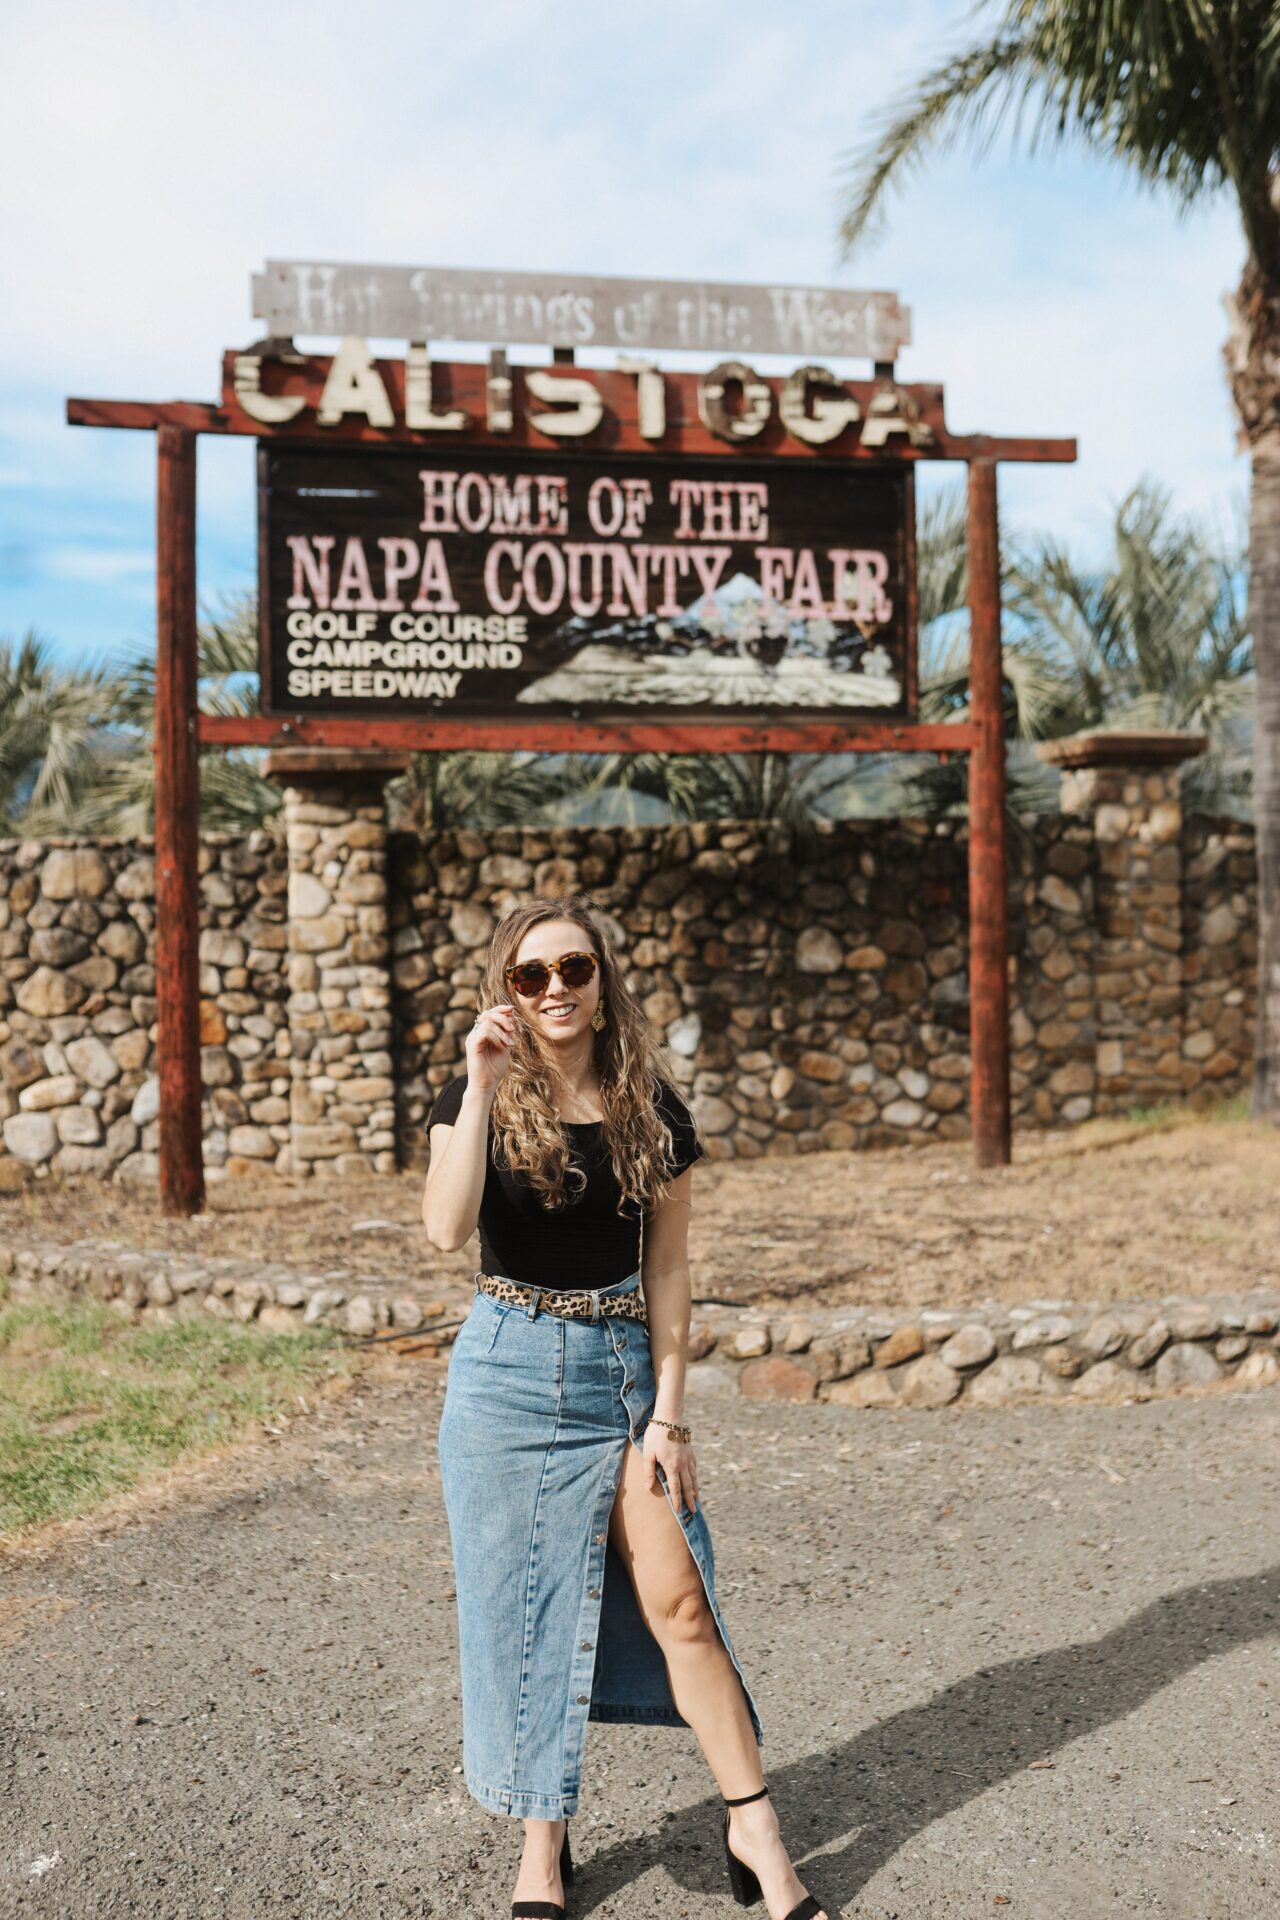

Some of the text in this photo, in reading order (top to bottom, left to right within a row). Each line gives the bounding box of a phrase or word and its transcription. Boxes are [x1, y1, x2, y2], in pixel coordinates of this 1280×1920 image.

[765, 288, 884, 353] West
[233, 335, 936, 447] CALISTOGA
[419, 470, 769, 542] HOME OF THE
[287, 536, 893, 623] NAPA COUNTY FAIR
[287, 612, 529, 643] GOLF COURSE
[287, 641, 523, 670] CAMPGROUND
[288, 669, 463, 699] SPEEDWAY
